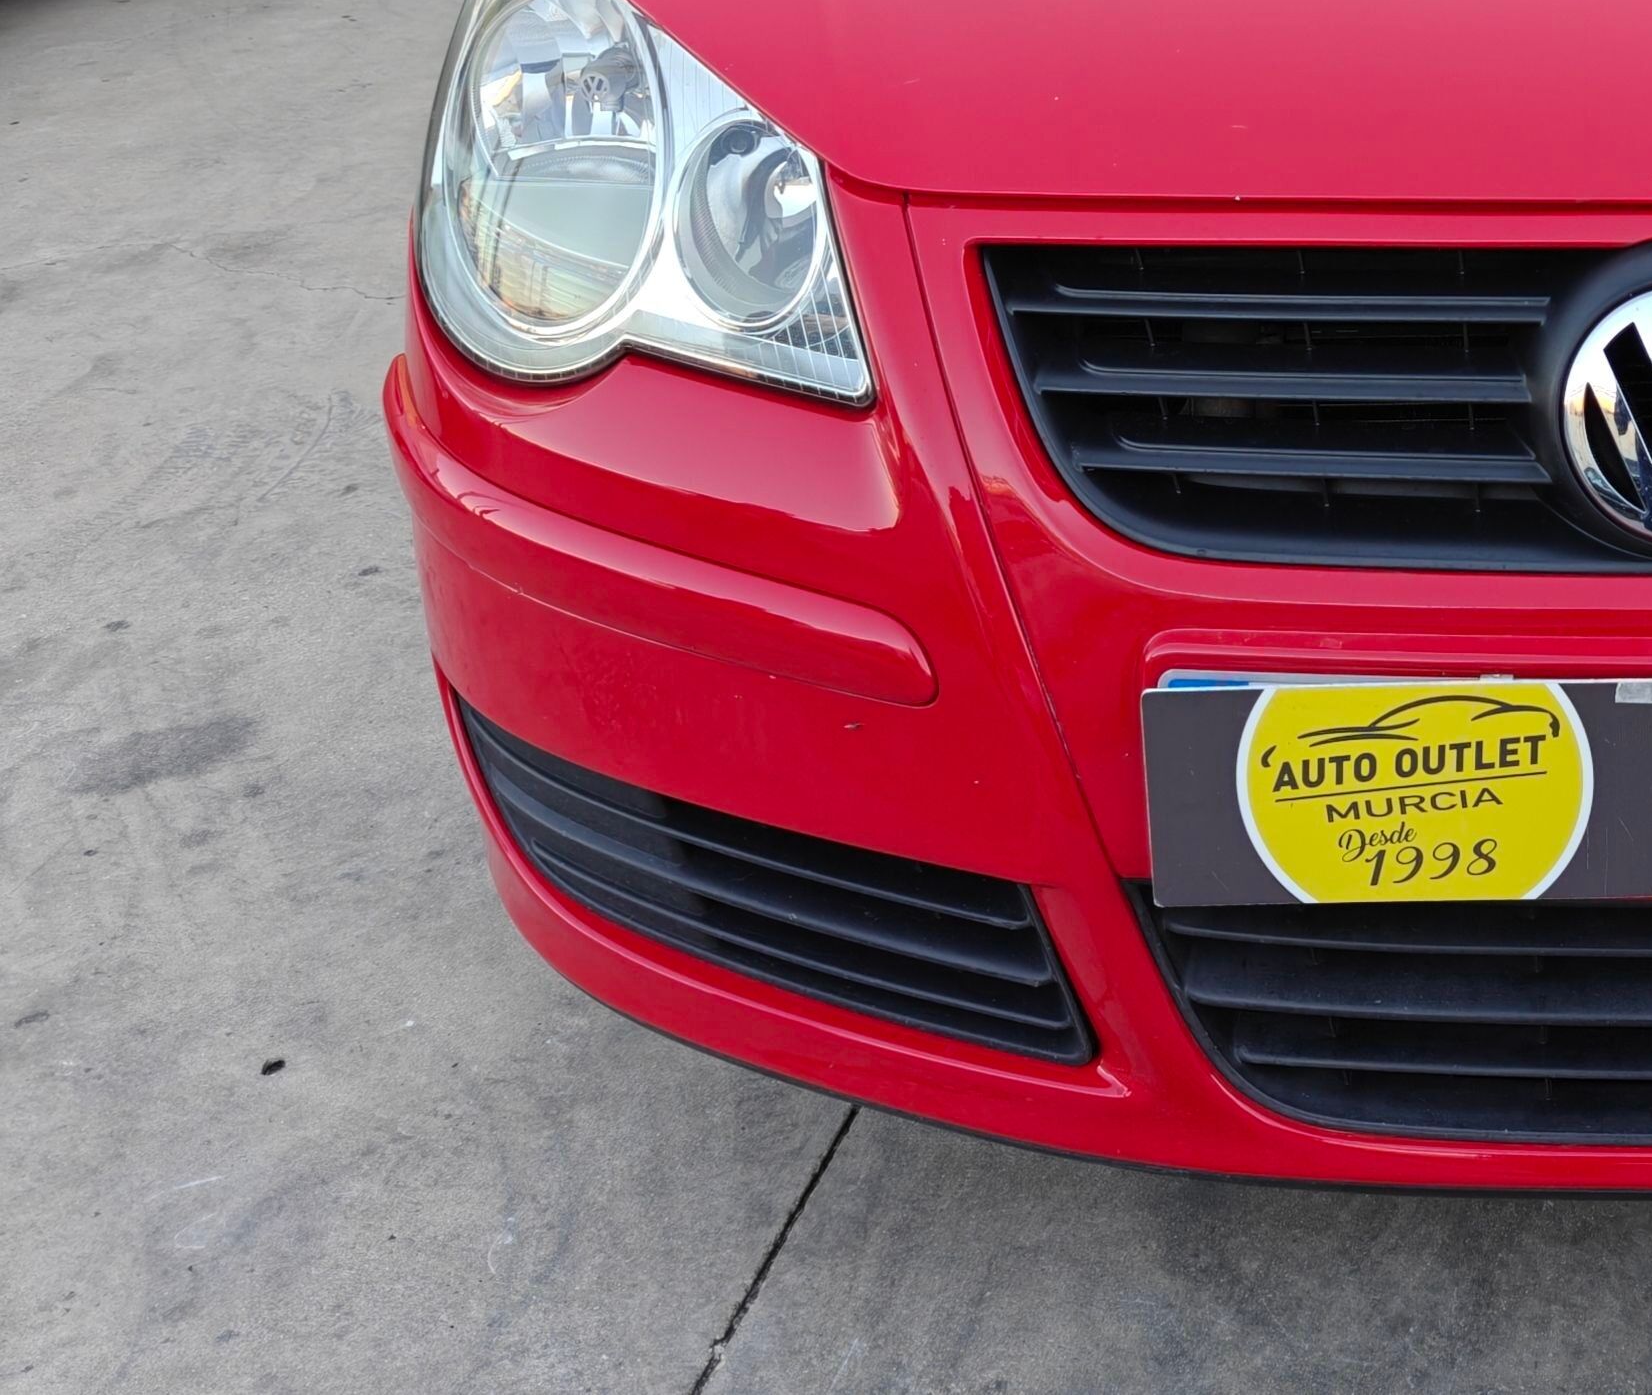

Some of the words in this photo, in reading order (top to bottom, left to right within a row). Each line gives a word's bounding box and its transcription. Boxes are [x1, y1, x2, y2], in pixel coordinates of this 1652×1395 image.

[1272, 752, 1377, 793] AUTO
[1394, 734, 1547, 779] OUTLET
[1326, 787, 1503, 823] MURCIA
[1338, 821, 1418, 863] Desde
[1364, 837, 1498, 886] 1998
